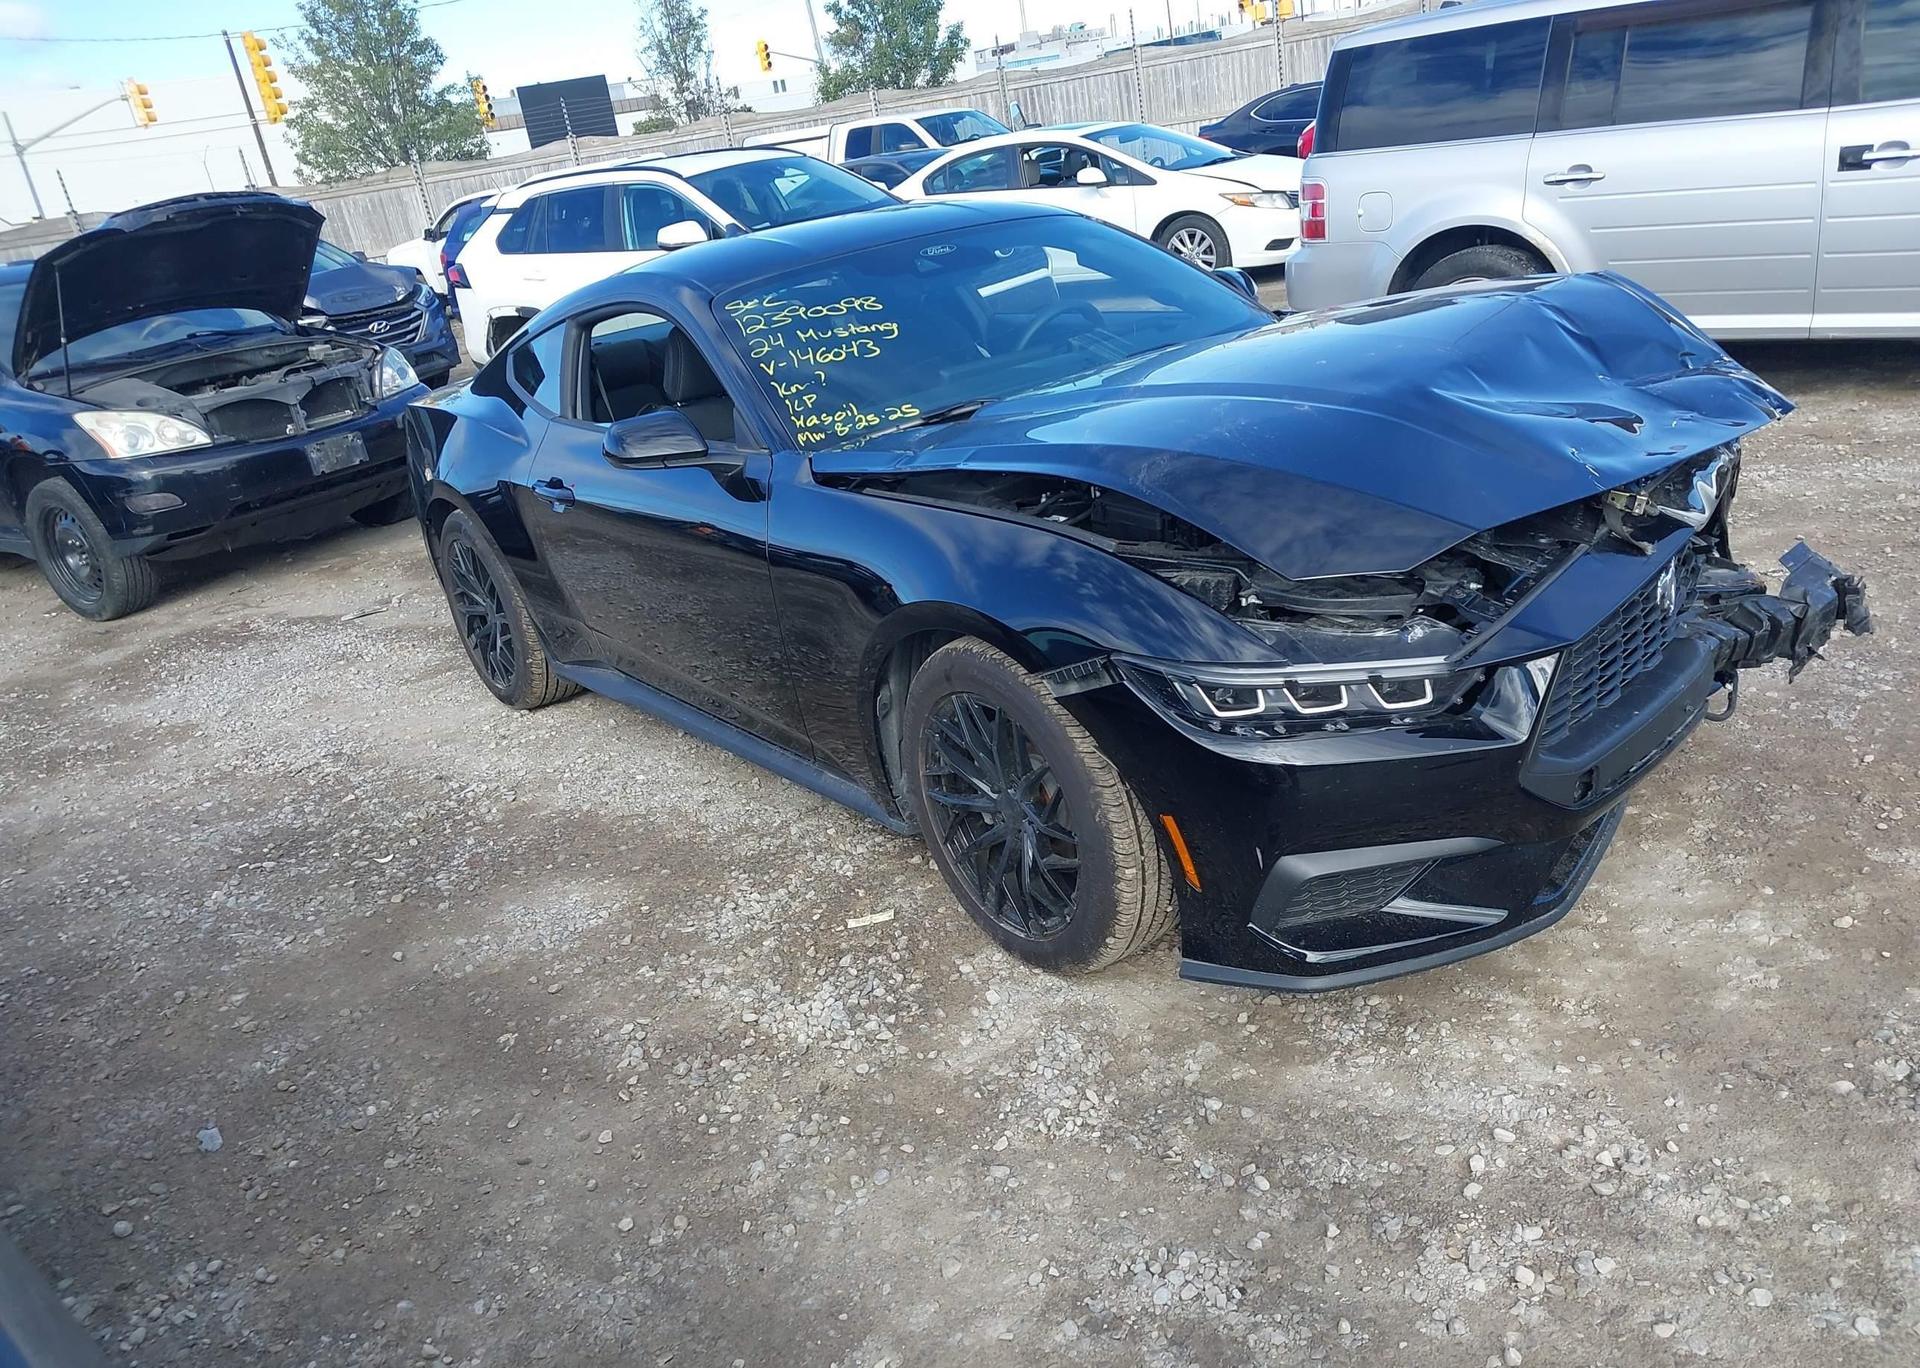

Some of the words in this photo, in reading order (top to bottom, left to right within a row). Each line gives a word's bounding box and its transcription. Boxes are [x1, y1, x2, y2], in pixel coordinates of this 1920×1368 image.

[736, 296, 883, 337] 12390098
[749, 333, 785, 358] 24
[796, 321, 899, 342] Mustang
